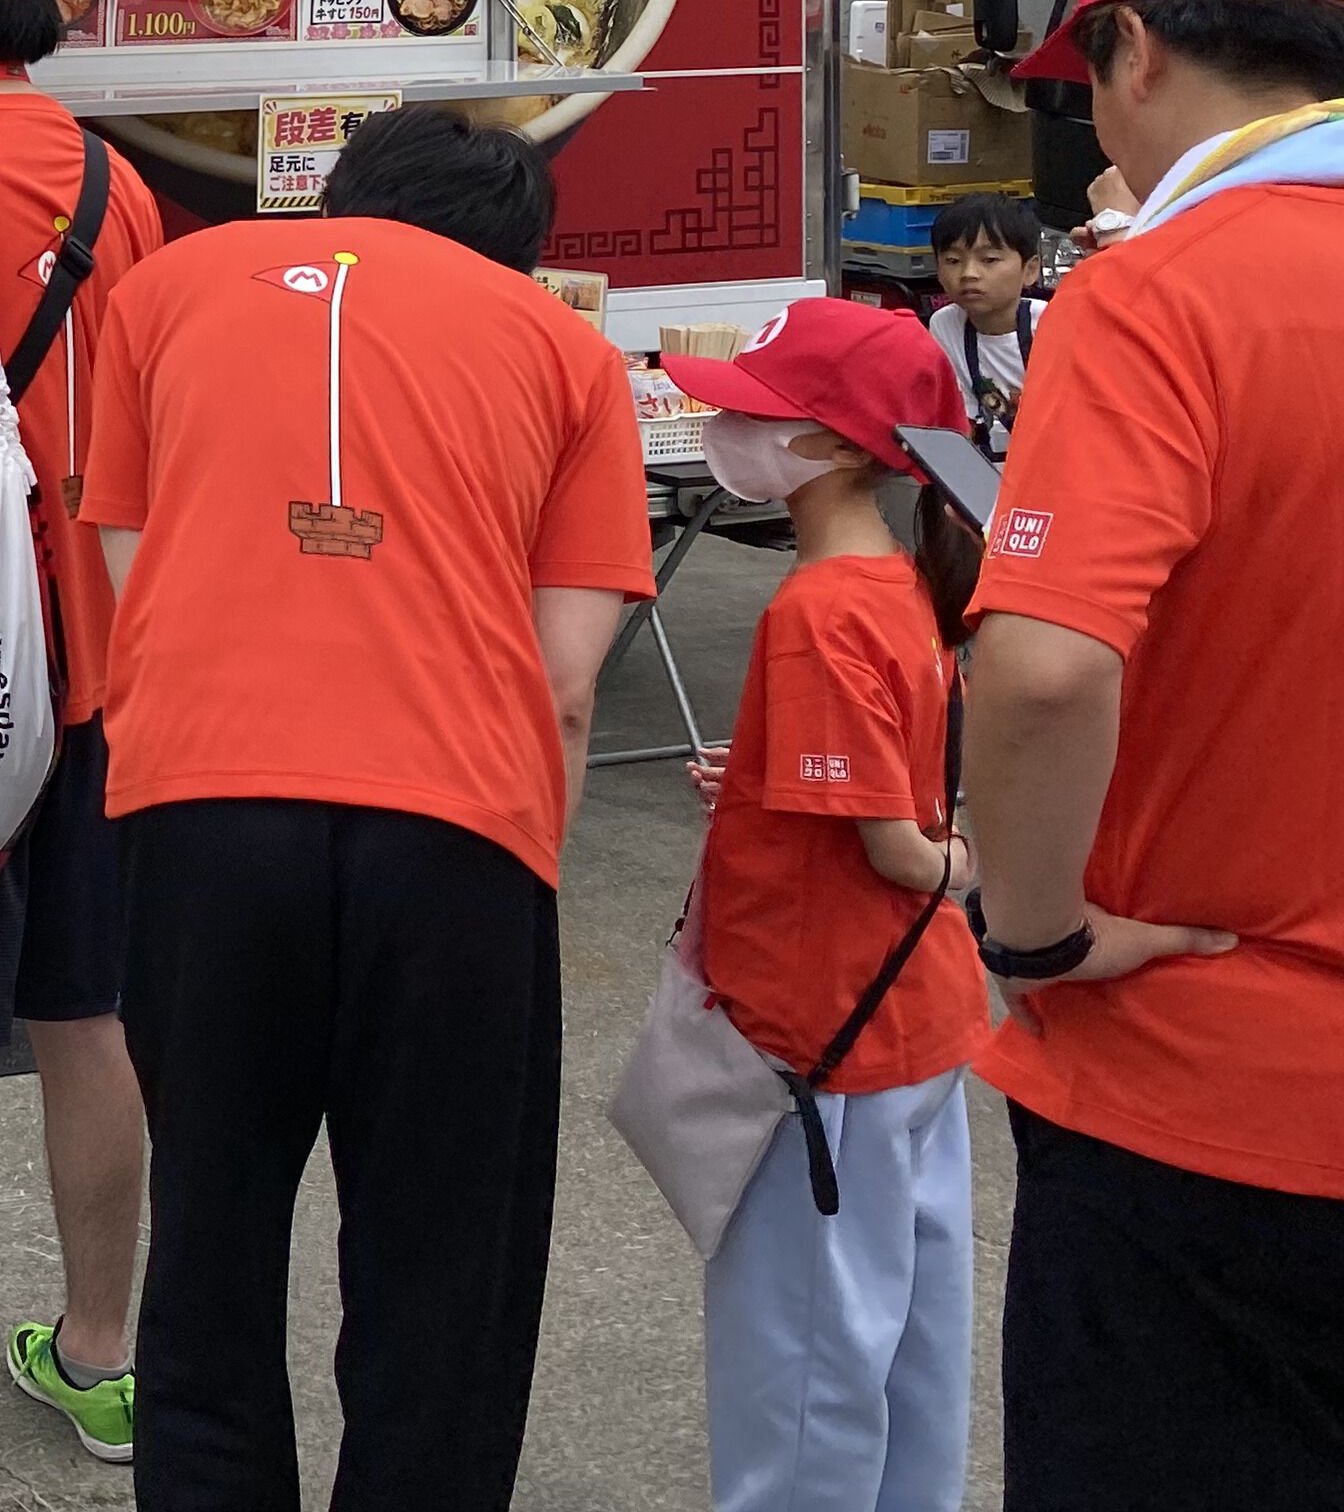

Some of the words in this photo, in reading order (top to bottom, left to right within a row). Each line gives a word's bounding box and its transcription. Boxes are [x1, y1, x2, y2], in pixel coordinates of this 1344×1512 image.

[315, 8, 347, 21] 牛すじ
[349, 6, 380, 20] 150円
[269, 155, 315, 173] 足元に
[1014, 515, 1044, 534] UNI
[1009, 533, 1040, 551] QLO
